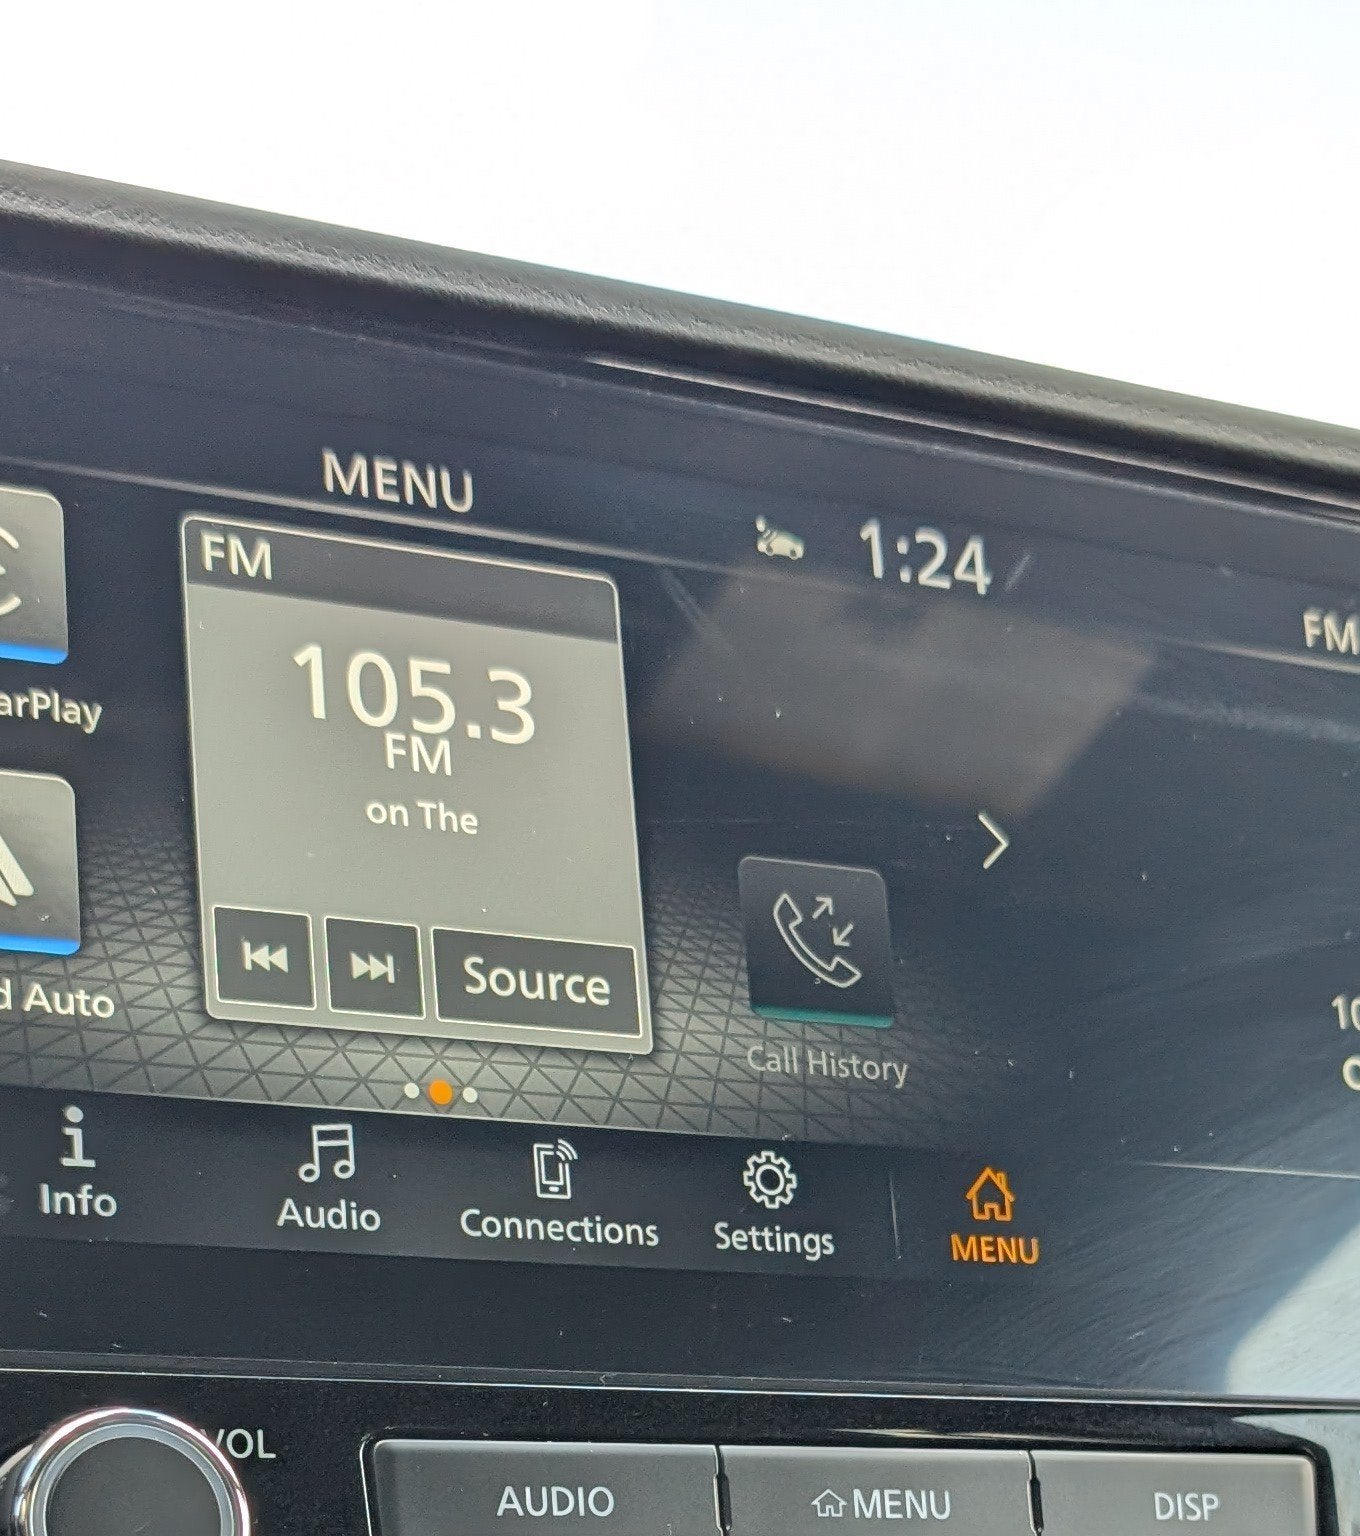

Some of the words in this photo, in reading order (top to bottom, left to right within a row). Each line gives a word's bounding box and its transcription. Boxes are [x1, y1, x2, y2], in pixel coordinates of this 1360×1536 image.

[322, 447, 475, 515] MENU
[199, 532, 274, 581] FM
[859, 519, 993, 595] 1:24
[291, 643, 536, 745] 105.3
[384, 732, 453, 776] FM
[366, 800, 409, 828] on
[418, 802, 479, 835] The
[462, 955, 611, 1006] Source
[22, 983, 116, 1019] Auto
[746, 1045, 800, 1075] Call
[807, 1050, 909, 1088] History
[40, 1183, 117, 1218] Info
[277, 1198, 383, 1232] Audio
[459, 1208, 660, 1248] Connections
[713, 1222, 836, 1262] Settings
[949, 1233, 1039, 1265] MENU
[496, 1485, 614, 1518] AUDIO
[853, 1489, 951, 1520] MENU
[1153, 1492, 1220, 1522] DISP
